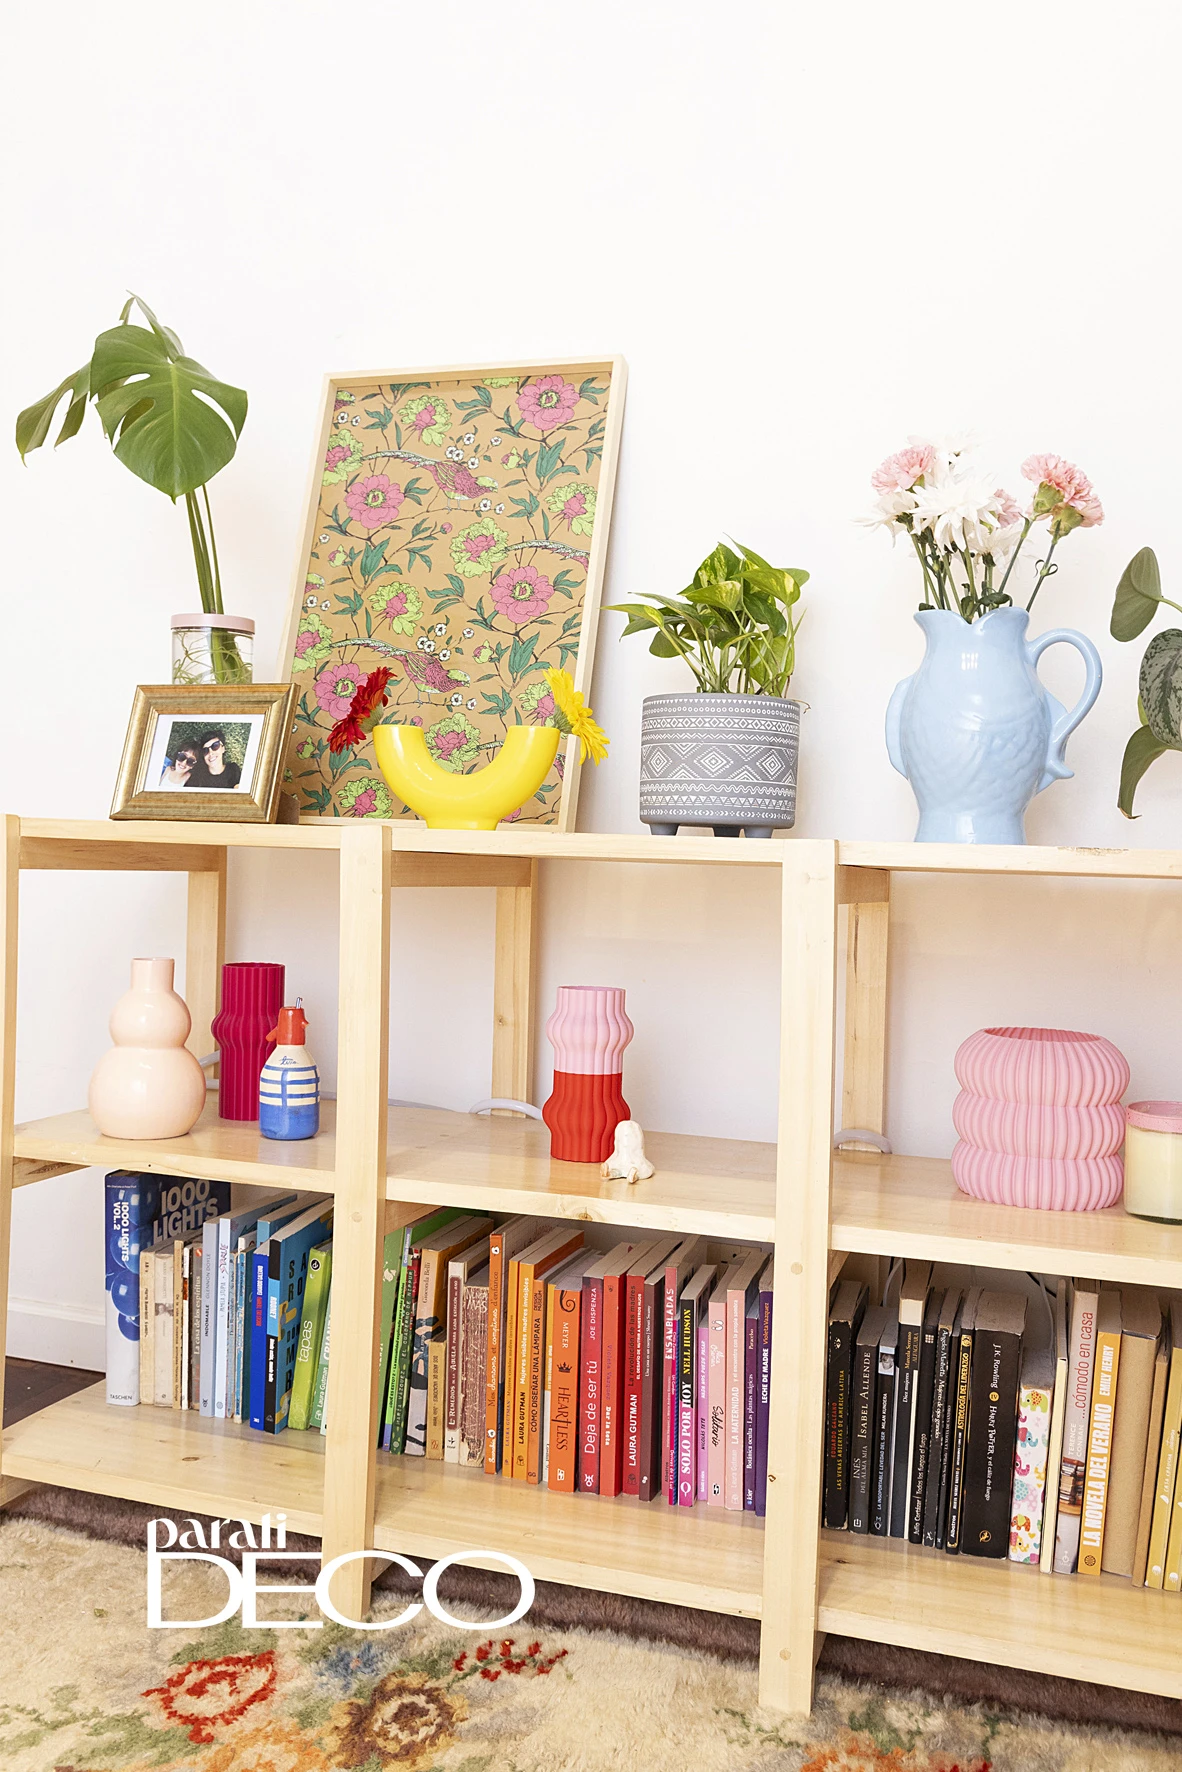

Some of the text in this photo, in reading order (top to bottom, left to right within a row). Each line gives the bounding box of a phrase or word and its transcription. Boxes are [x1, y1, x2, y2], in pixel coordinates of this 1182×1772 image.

[161, 1179, 210, 1216] 1000
[113, 1201, 121, 1231] VOL. 2
[153, 1197, 219, 1247] LIGHTS
[121, 1201, 130, 1262] 1000 LIGHTS
[423, 1261, 431, 1276] Belli
[422, 1276, 430, 1304] Gioconda
[490, 1271, 499, 1307] d'enfance
[629, 1285, 637, 1312] madres
[194, 1319, 202, 1328] de
[629, 1326, 636, 1336] de
[1080, 1312, 1094, 1340] casa
[194, 1347, 202, 1355] La
[297, 1320, 313, 1363] tapas
[521, 1334, 529, 1358] visibles
[682, 1309, 692, 1375] NELL HUDSON
[911, 1332, 919, 1363] ALFAGUARA
[1078, 1343, 1091, 1358] en
[627, 1337, 636, 1378] revolución
[762, 1348, 770, 1373] MADRE
[959, 1352, 969, 1384] LIDERAZGO
[319, 1366, 329, 1391] Gutman
[487, 1355, 497, 1391] chansons
[519, 1359, 528, 1385] Mujeres
[530, 1318, 542, 1433] CÓMO DISEÑAR UNA LÁMPARA
[628, 1379, 635, 1387] La
[762, 1373, 769, 1383] DE
[990, 1359, 1001, 1389] Rowling
[1099, 1344, 1115, 1397] EMILY HENRY
[316, 1391, 325, 1408] Laura
[487, 1390, 496, 1407] Mes
[936, 1379, 946, 1402] Mujeres
[958, 1384, 967, 1395] DEL
[519, 1392, 527, 1421] GUTMAN
[584, 1360, 598, 1454] Deja de ser tú
[731, 1386, 740, 1433] MATERNIDAD
[746, 1395, 755, 1414] plantas
[935, 1408, 943, 1419] ojos
[988, 1404, 998, 1428] HARRY
[551, 1386, 573, 1452] HEARTLESS
[628, 1394, 638, 1467] LAURA GUTMAN
[680, 1381, 692, 1475] SOLO POR HOY
[711, 1405, 725, 1447] Solitario
[746, 1414, 754, 1424] Las
[838, 1420, 843, 1428] DE
[934, 1418, 943, 1439] grandes
[518, 1421, 526, 1445] LAURA
[731, 1435, 738, 1444] LA
[919, 1433, 928, 1448] fuego
[986, 1428, 997, 1456] POTTER
[1067, 1422, 1077, 1456] TERENCE
[1076, 1423, 1085, 1457] CONRAN
[745, 1445, 754, 1469] Botánica
[853, 1457, 861, 1479] INÉS
[917, 1454, 926, 1471] fuegos
[915, 1480, 923, 1495] Todos
[985, 1478, 992, 1486] de
[1082, 1402, 1113, 1548] LA NOVELA DEL VERANO
[984, 1485, 993, 1502] fuego
